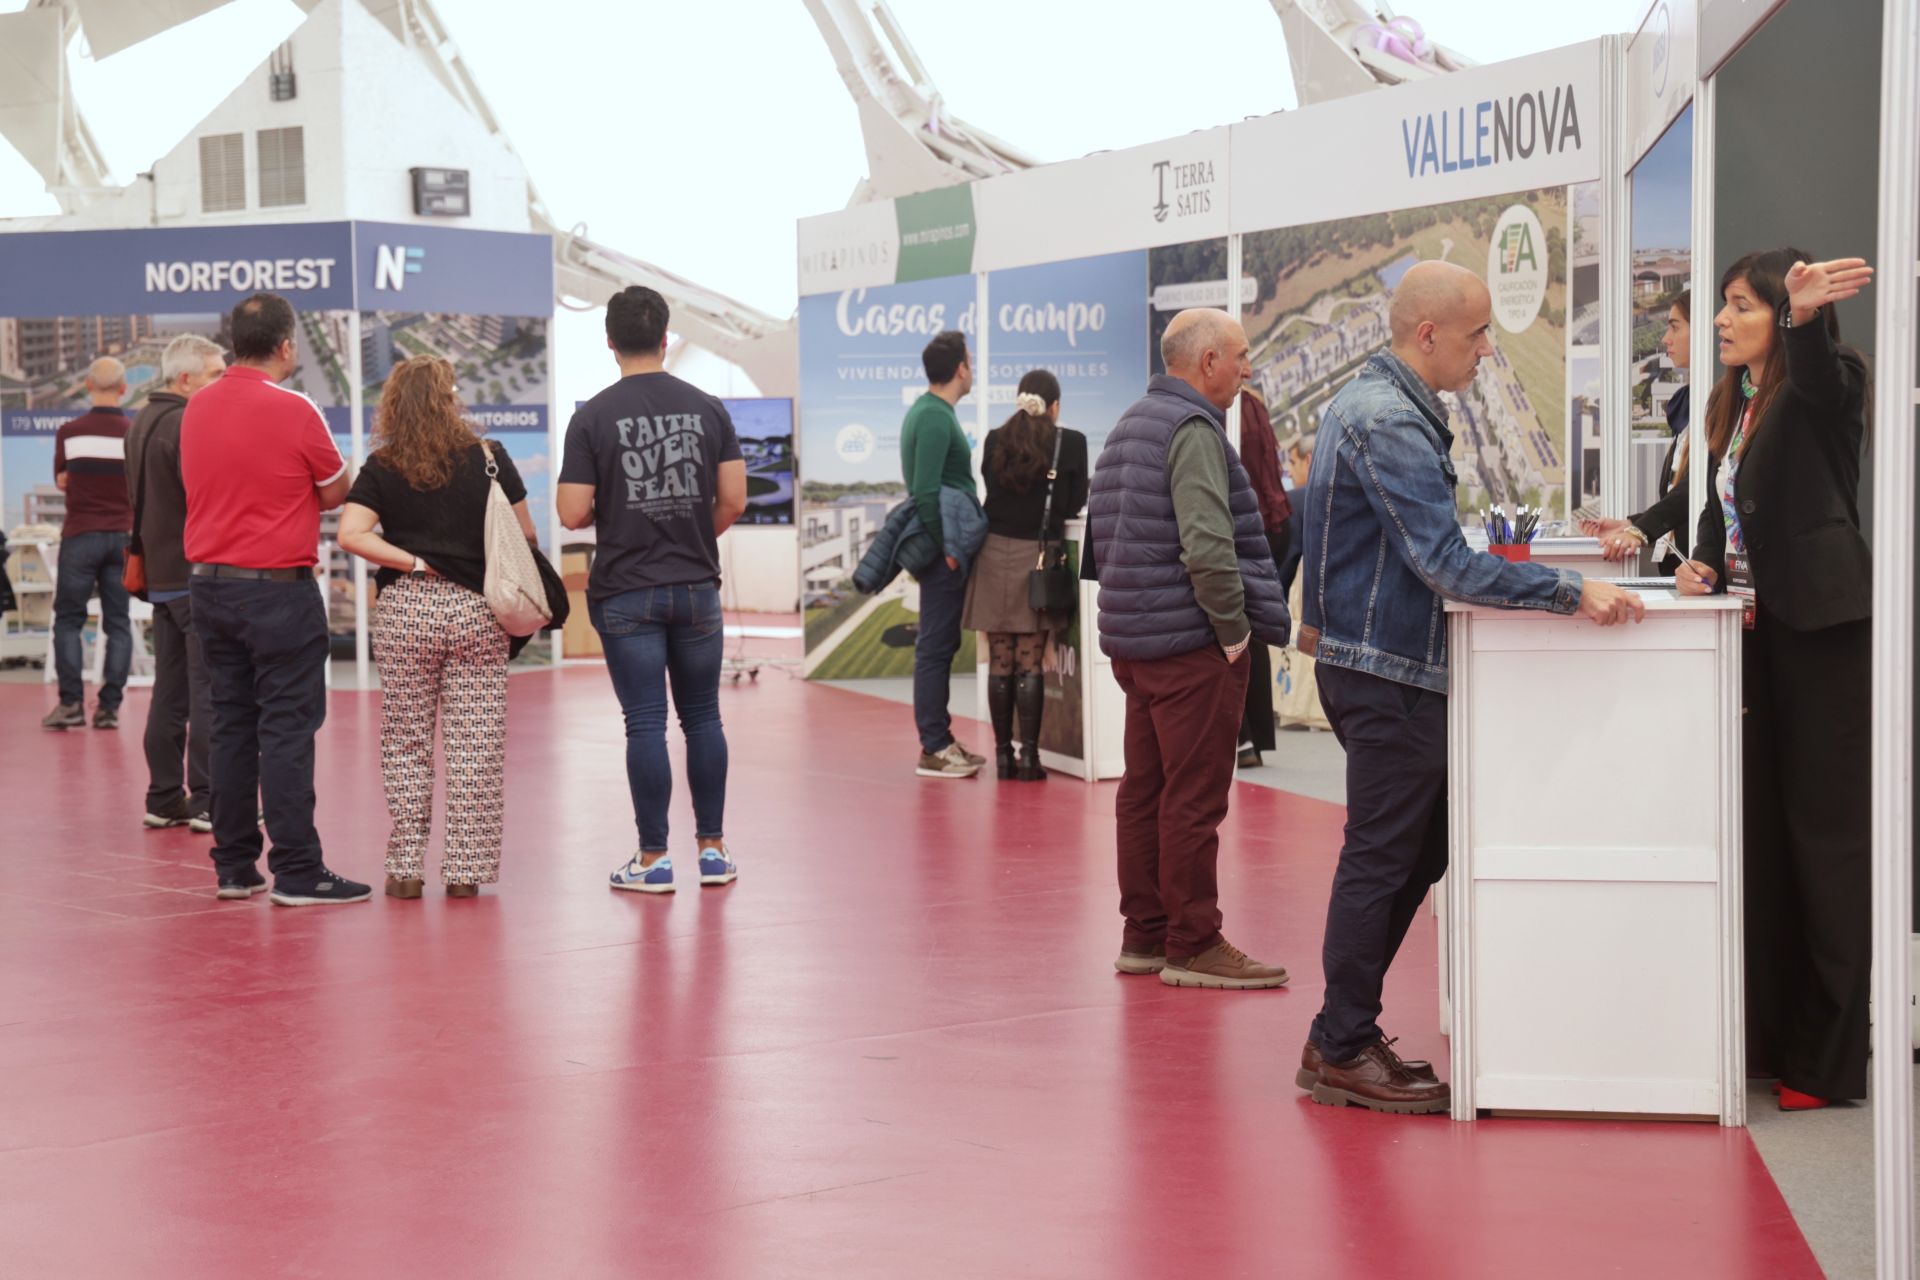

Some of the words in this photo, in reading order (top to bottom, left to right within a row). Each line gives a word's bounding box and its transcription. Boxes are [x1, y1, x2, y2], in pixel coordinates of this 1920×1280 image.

[1402, 83, 1582, 179] VALLENOVA
[1173, 160, 1215, 189] TERRA
[1176, 190, 1211, 217] SATIS
[145, 258, 336, 292] NORFOREST
[836, 287, 946, 337] Casas
[999, 302, 1105, 348] campo
[838, 364, 927, 381] VIVIENDA
[616, 413, 704, 448] FAITH
[621, 431, 703, 479] OVER
[625, 462, 700, 502] FEAR
